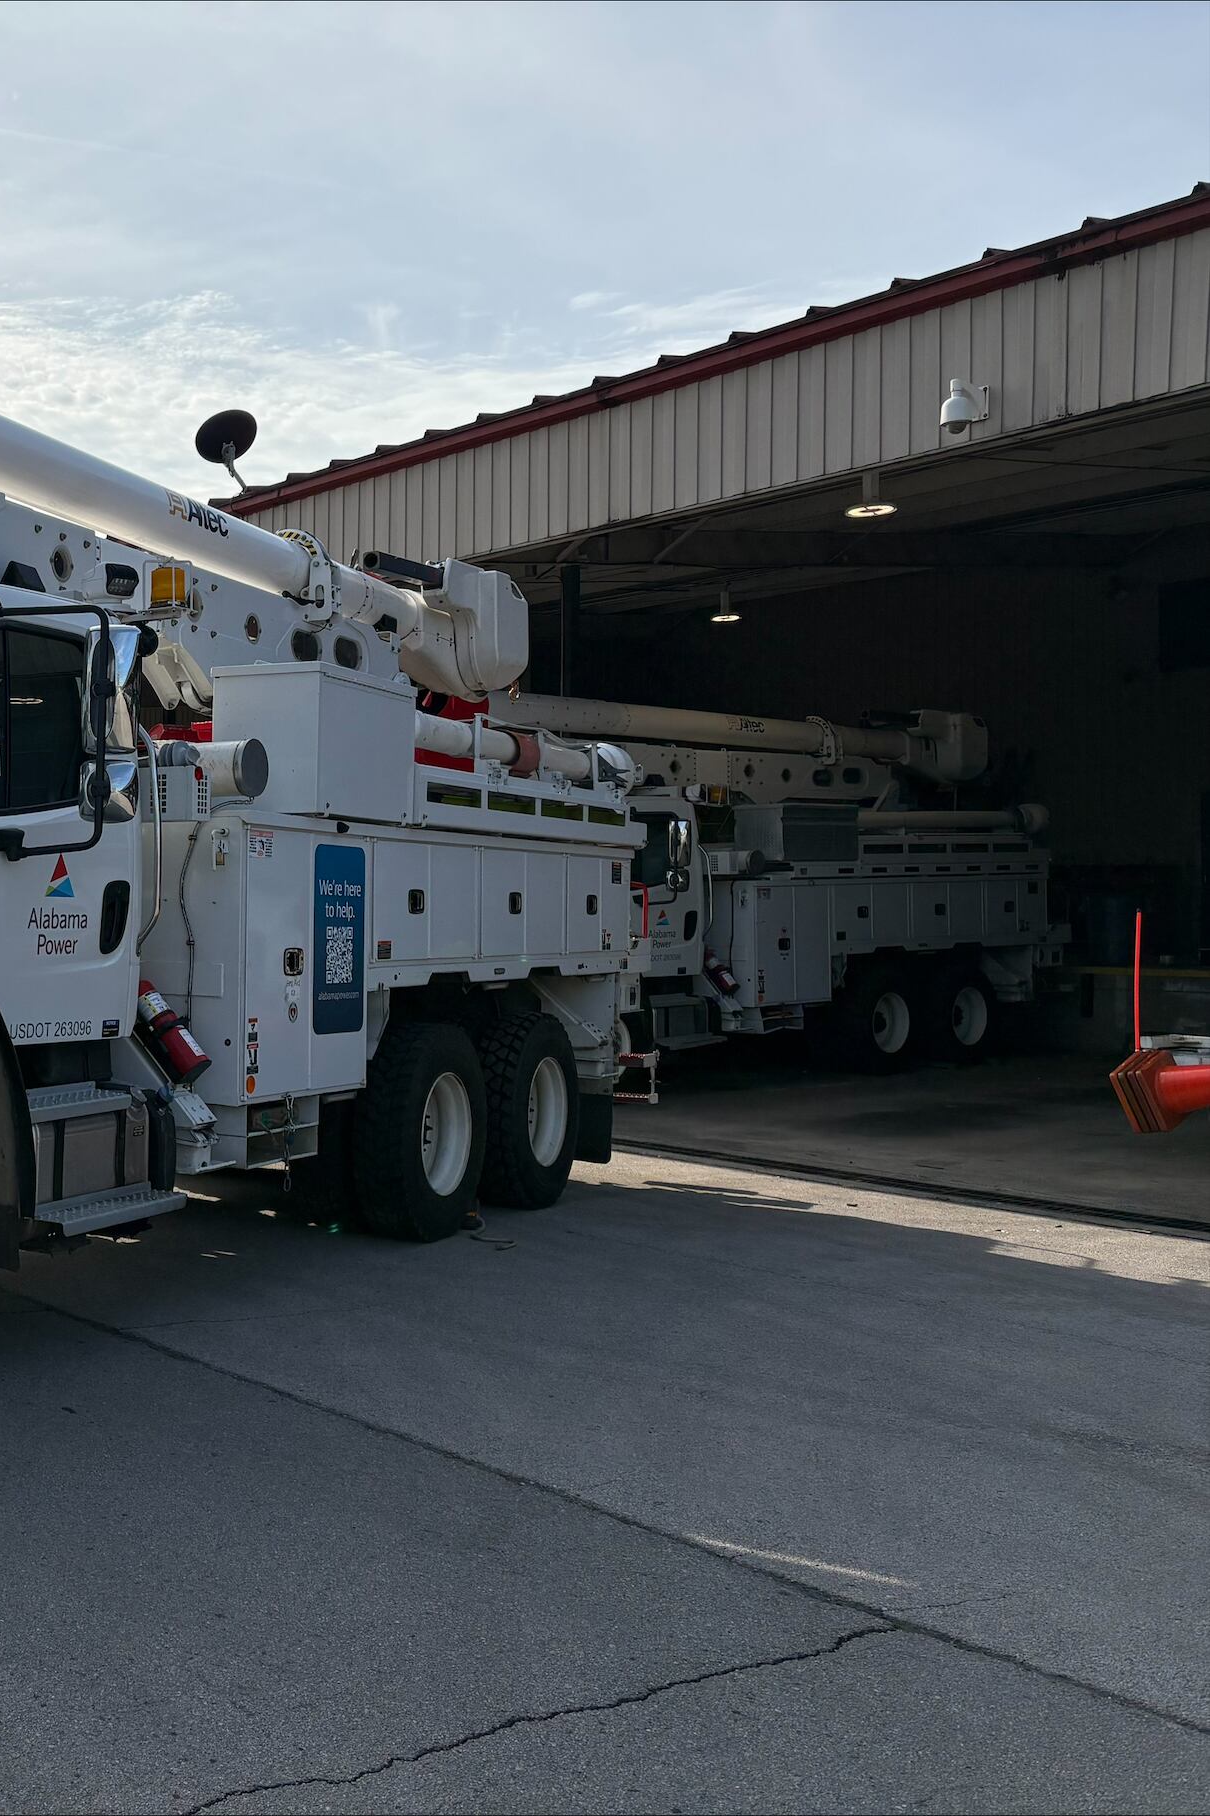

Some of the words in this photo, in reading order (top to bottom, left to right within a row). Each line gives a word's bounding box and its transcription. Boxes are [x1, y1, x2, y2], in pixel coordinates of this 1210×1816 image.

[187, 498, 228, 537] Altec
[319, 879, 343, 897] We're
[344, 880, 362, 897] here
[28, 907, 88, 930] Alabama
[325, 902, 335, 918] to
[336, 901, 356, 922] help.
[648, 930, 676, 939] Alabama
[652, 940, 672, 949] Power
[37, 934, 78, 956] Power
[9, 1022, 52, 1039] USDOT
[54, 1020, 92, 1037] 263096
